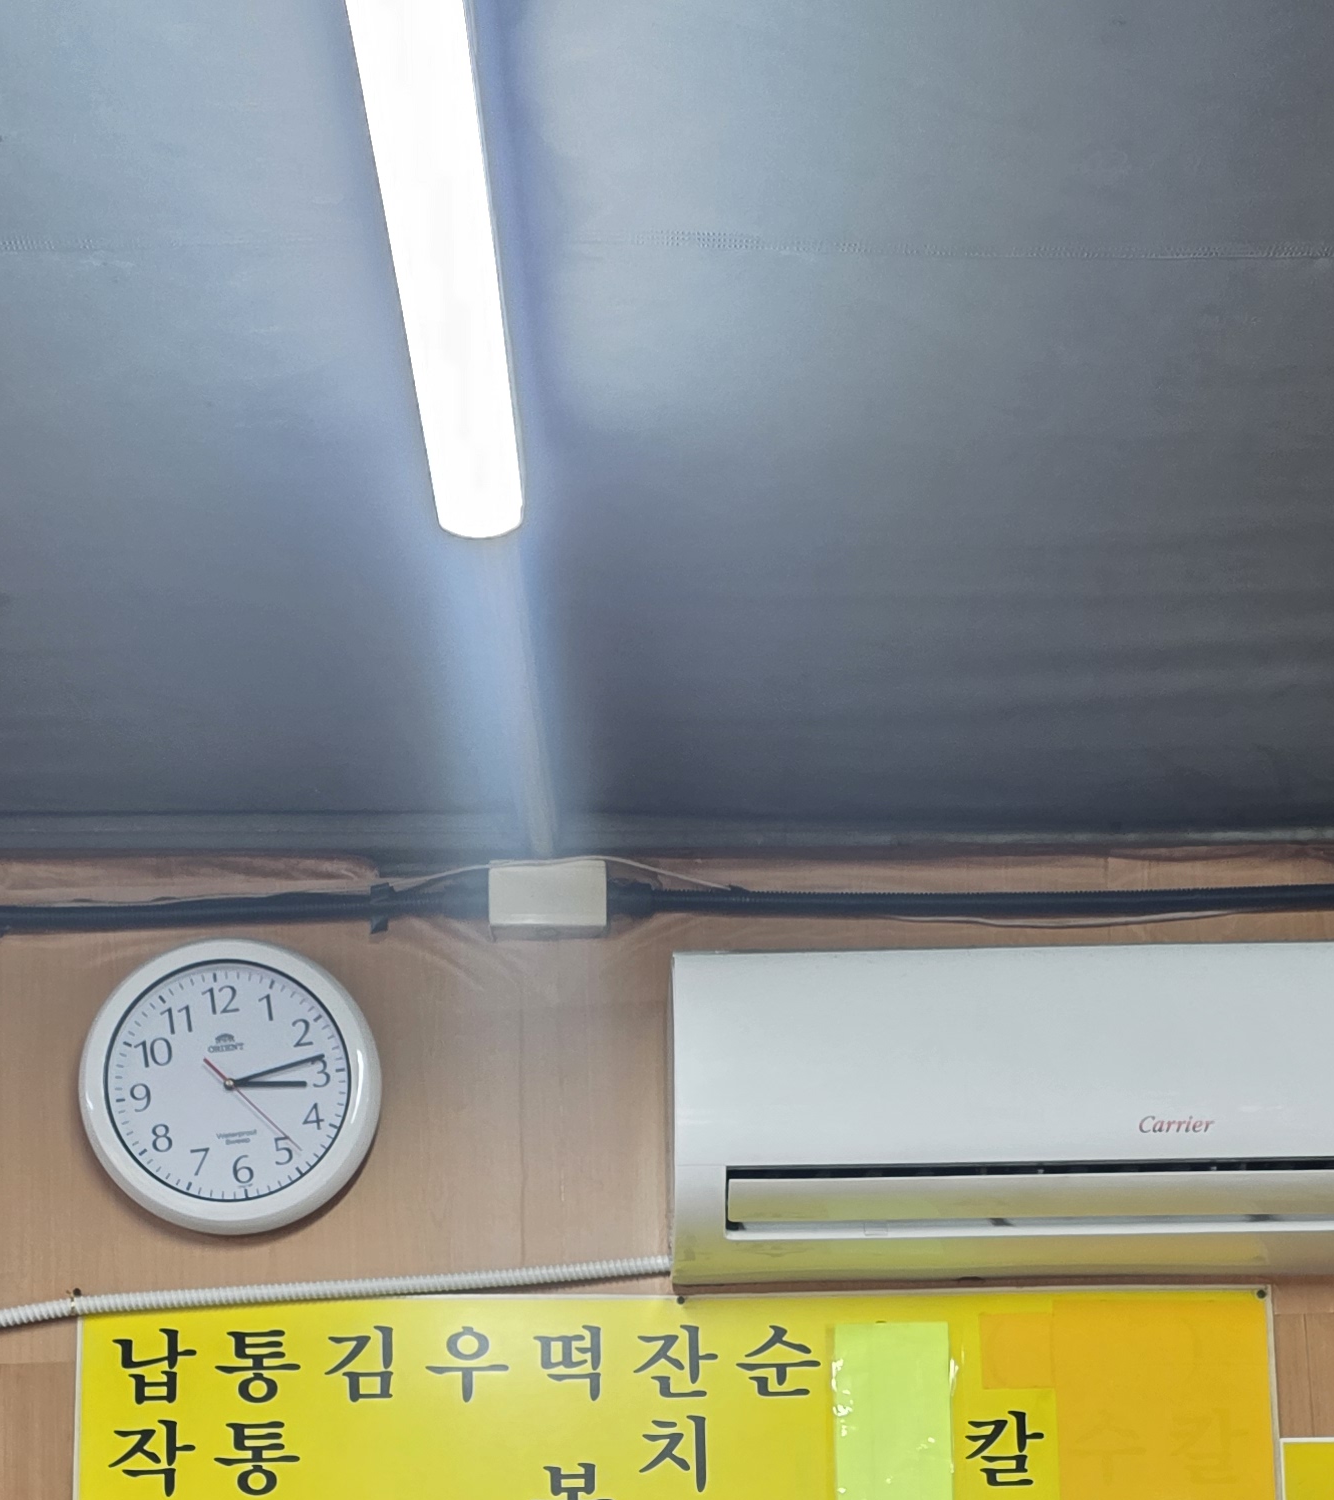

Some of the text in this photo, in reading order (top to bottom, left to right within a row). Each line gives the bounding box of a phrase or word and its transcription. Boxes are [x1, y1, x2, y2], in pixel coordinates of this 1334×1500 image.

[202, 985, 240, 1015] 12
[258, 994, 274, 1021] 1
[160, 1004, 193, 1035] 11
[292, 1018, 313, 1048] 2
[134, 1037, 173, 1068] 10
[311, 1056, 331, 1088] 3
[129, 1083, 152, 1112] 9
[302, 1102, 325, 1131] 4
[1138, 1115, 1215, 1133] Carrier
[151, 1123, 173, 1152] 8
[274, 1135, 294, 1165] 5
[190, 1147, 210, 1176] 7
[232, 1154, 254, 1184] 6
